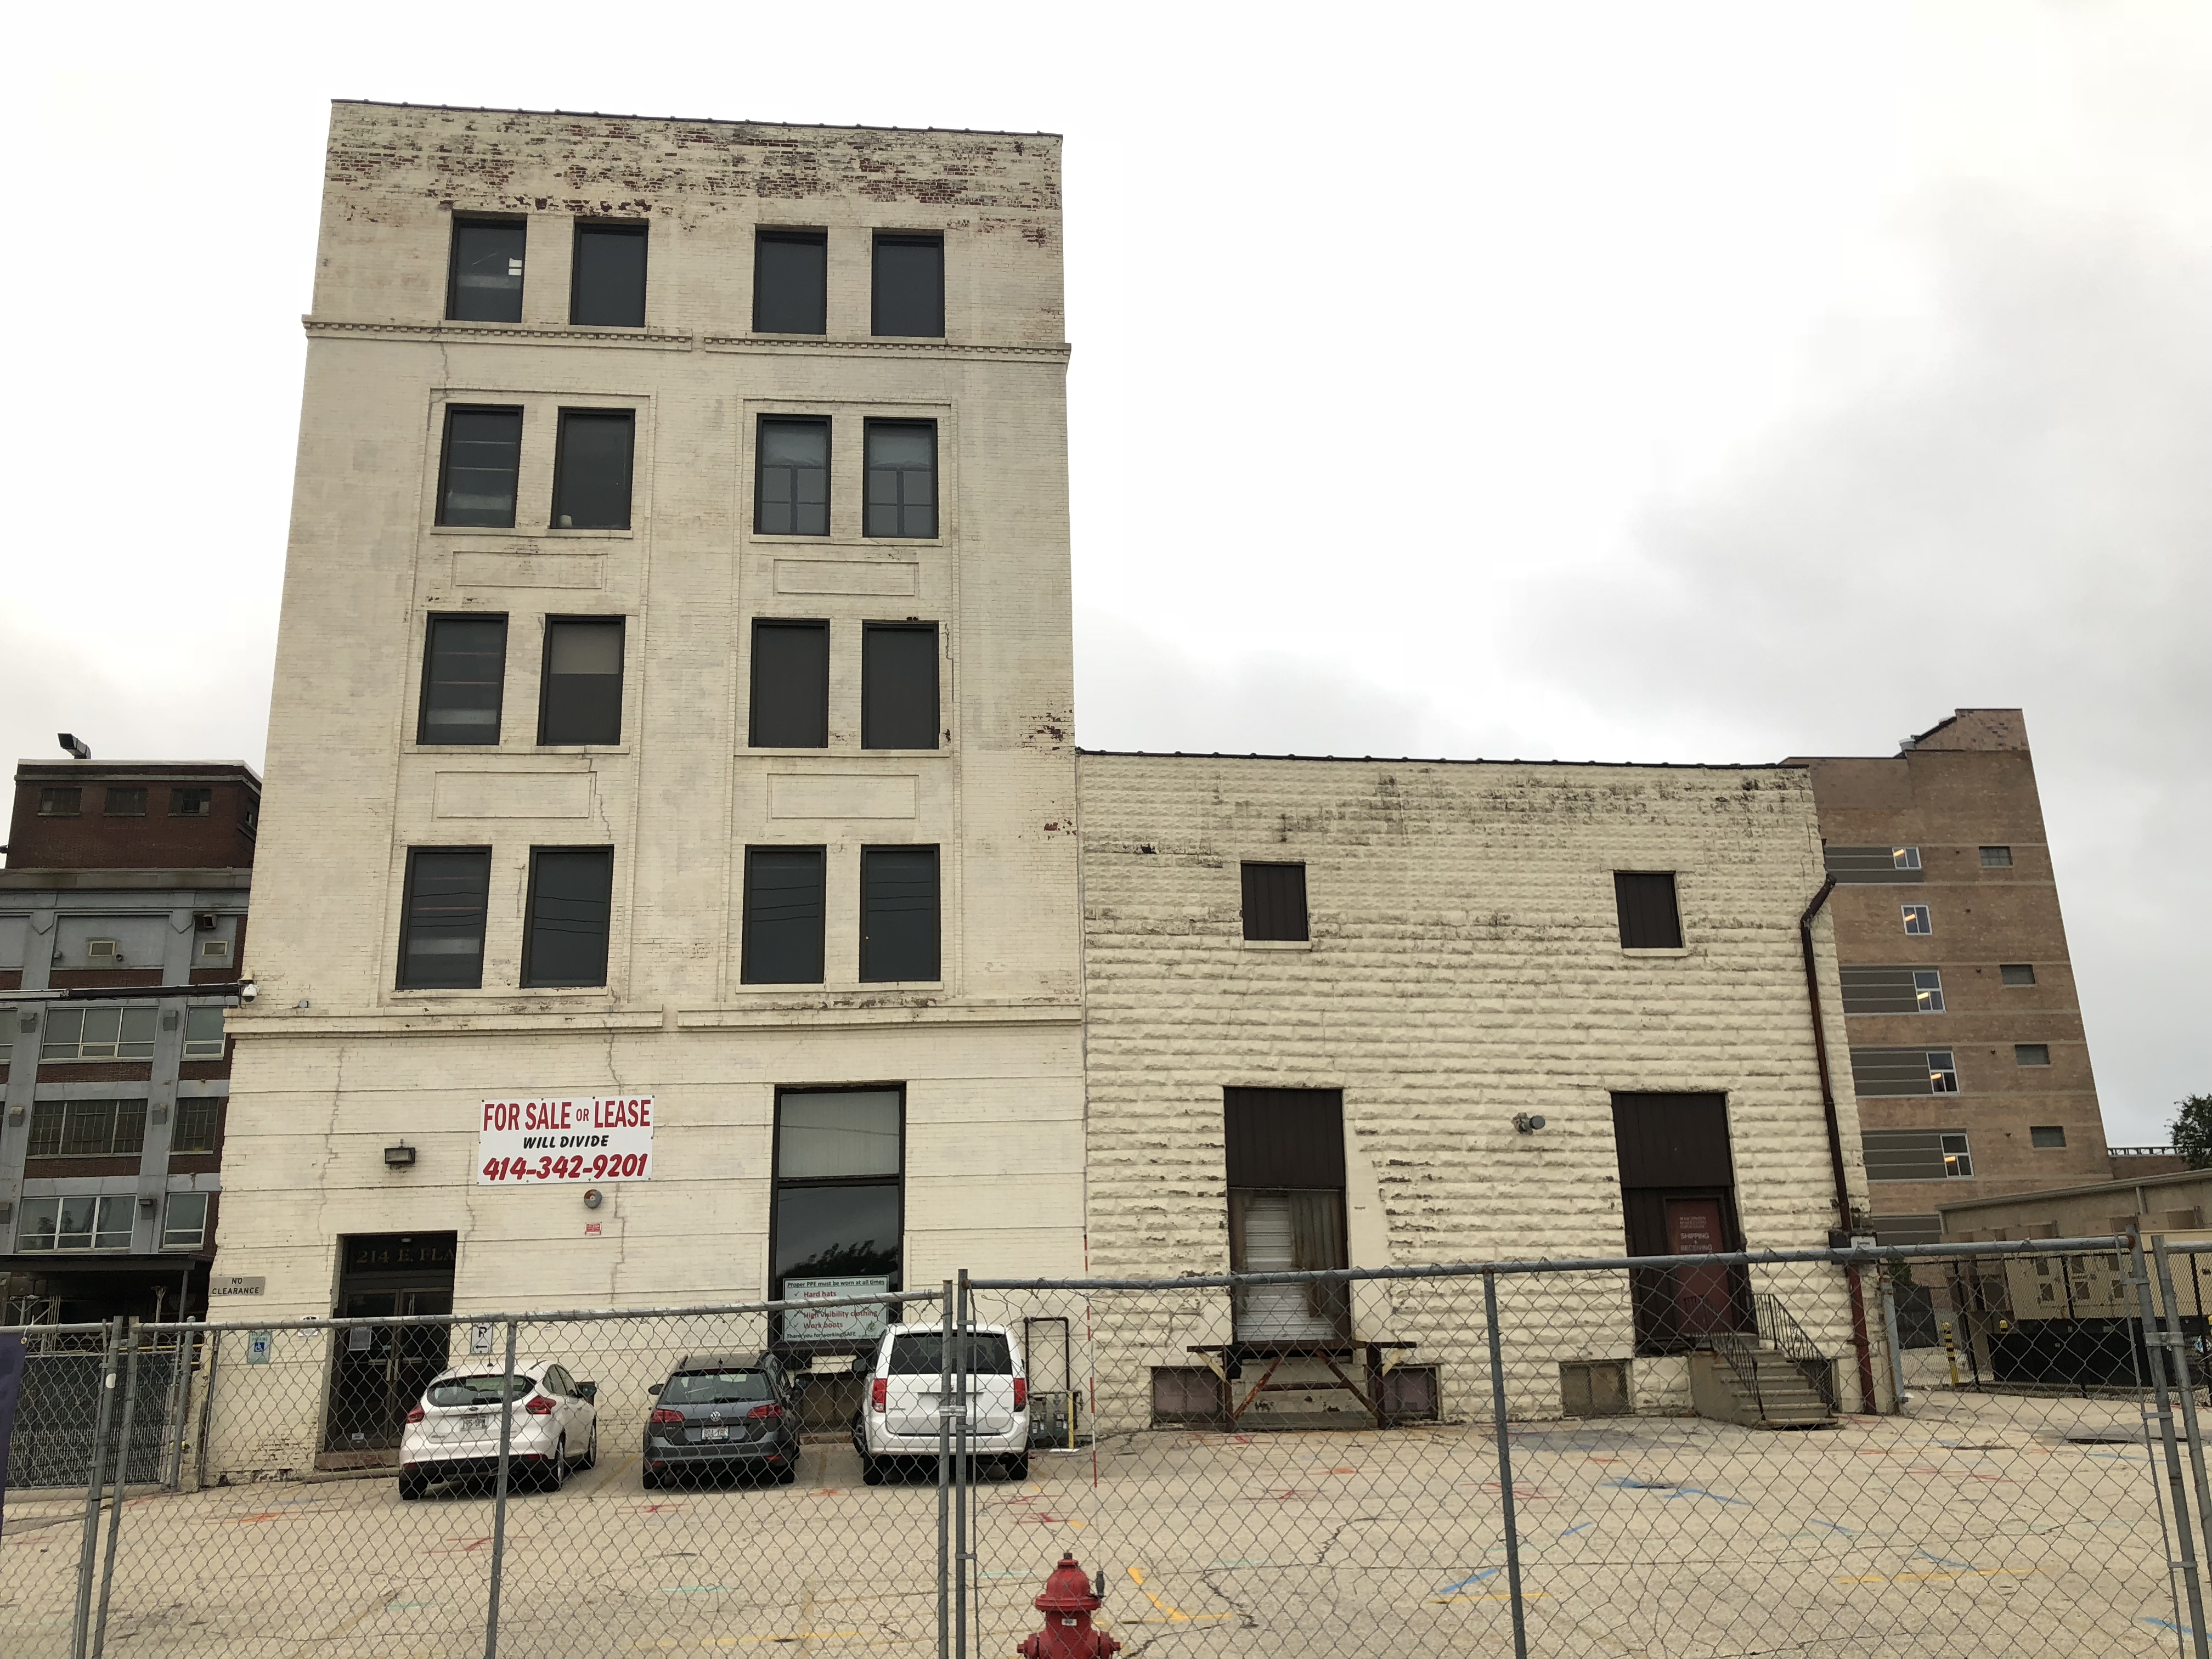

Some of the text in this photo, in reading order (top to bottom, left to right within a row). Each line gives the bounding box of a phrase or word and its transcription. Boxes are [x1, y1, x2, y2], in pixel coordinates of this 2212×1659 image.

[483, 1099, 651, 1131] FOR SALE OR LEASE
[523, 1135, 609, 1149] WILL DIVIDE
[482, 1153, 648, 1181] 414-342-9201
[357, 1250, 390, 1263] 214
